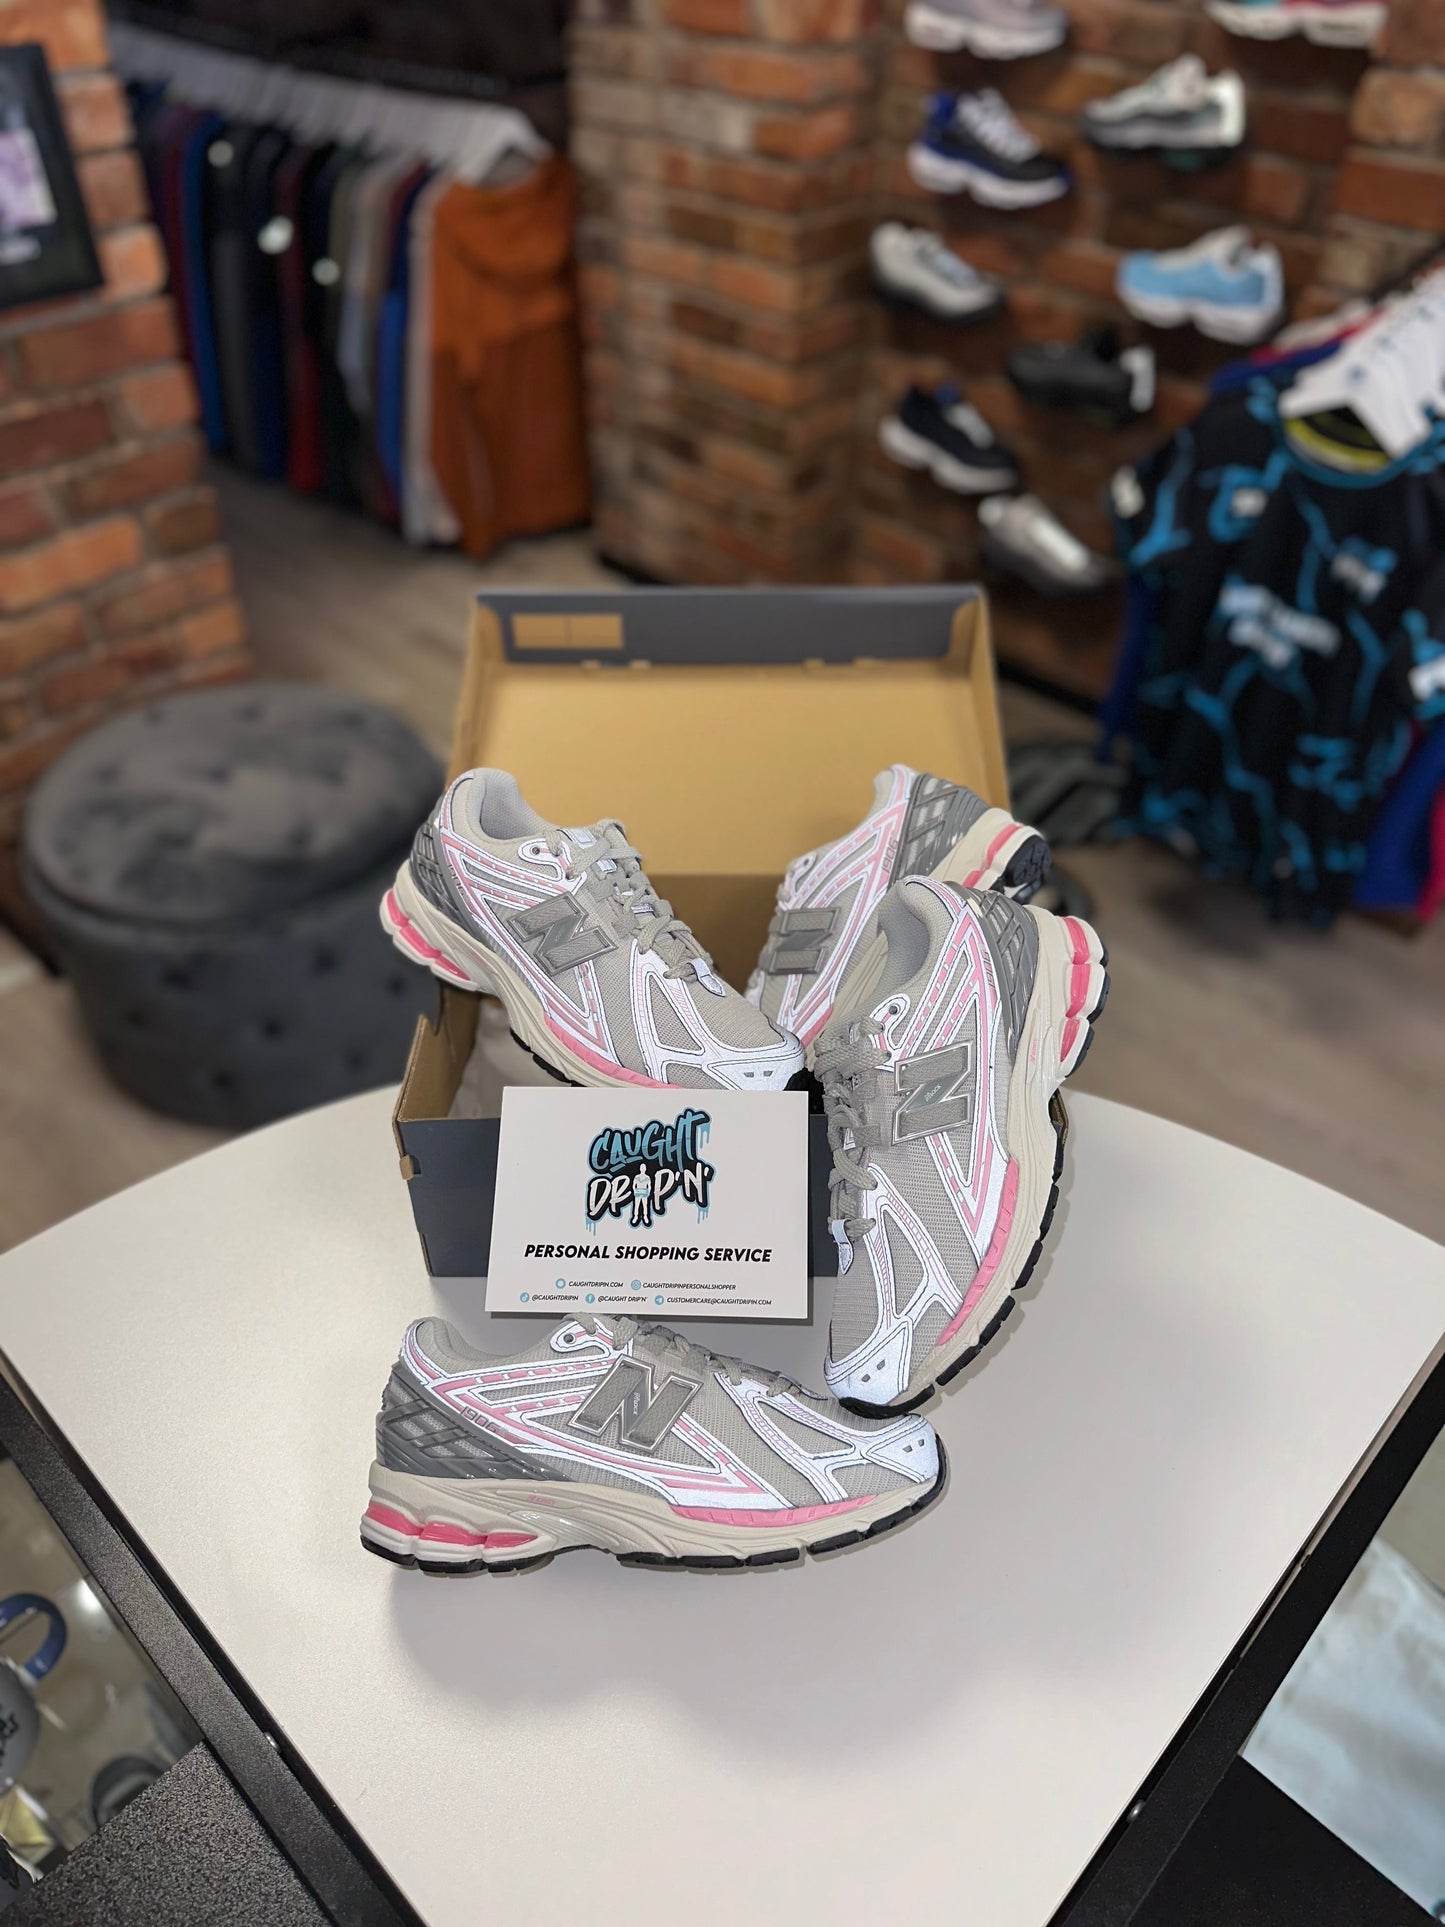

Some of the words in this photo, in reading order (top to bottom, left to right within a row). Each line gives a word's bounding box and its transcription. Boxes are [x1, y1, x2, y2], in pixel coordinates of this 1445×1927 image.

[506, 892, 618, 977] N
[892, 1041, 974, 1145] N
[590, 1109, 709, 1173] CAUGHT
[524, 1244, 610, 1259] PERSONAL
[614, 1246, 700, 1261] SHOPPING
[703, 1248, 772, 1263] SERVICE
[597, 1295, 628, 1303] @CAUGHT
[461, 1405, 502, 1434] 1906
[567, 1354, 704, 1452] N
